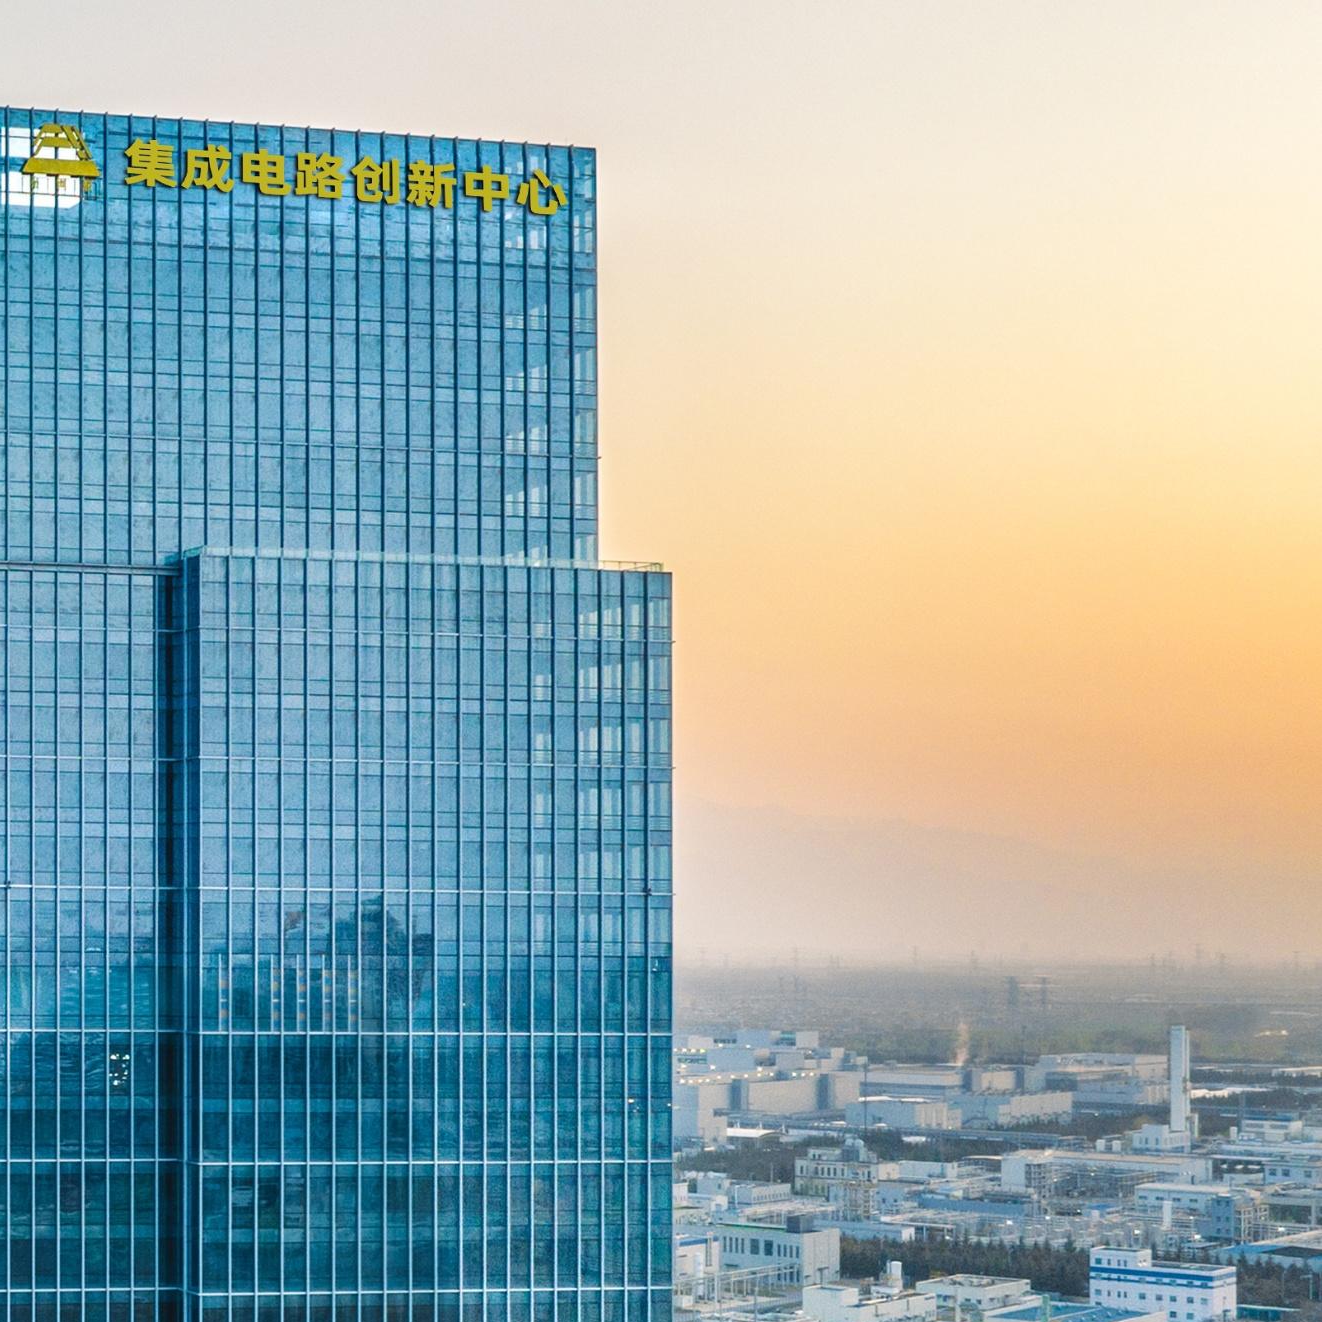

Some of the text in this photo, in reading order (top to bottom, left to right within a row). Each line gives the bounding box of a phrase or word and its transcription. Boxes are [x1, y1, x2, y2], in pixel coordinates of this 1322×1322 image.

[124, 138, 567, 215] 集成电路创新中心
